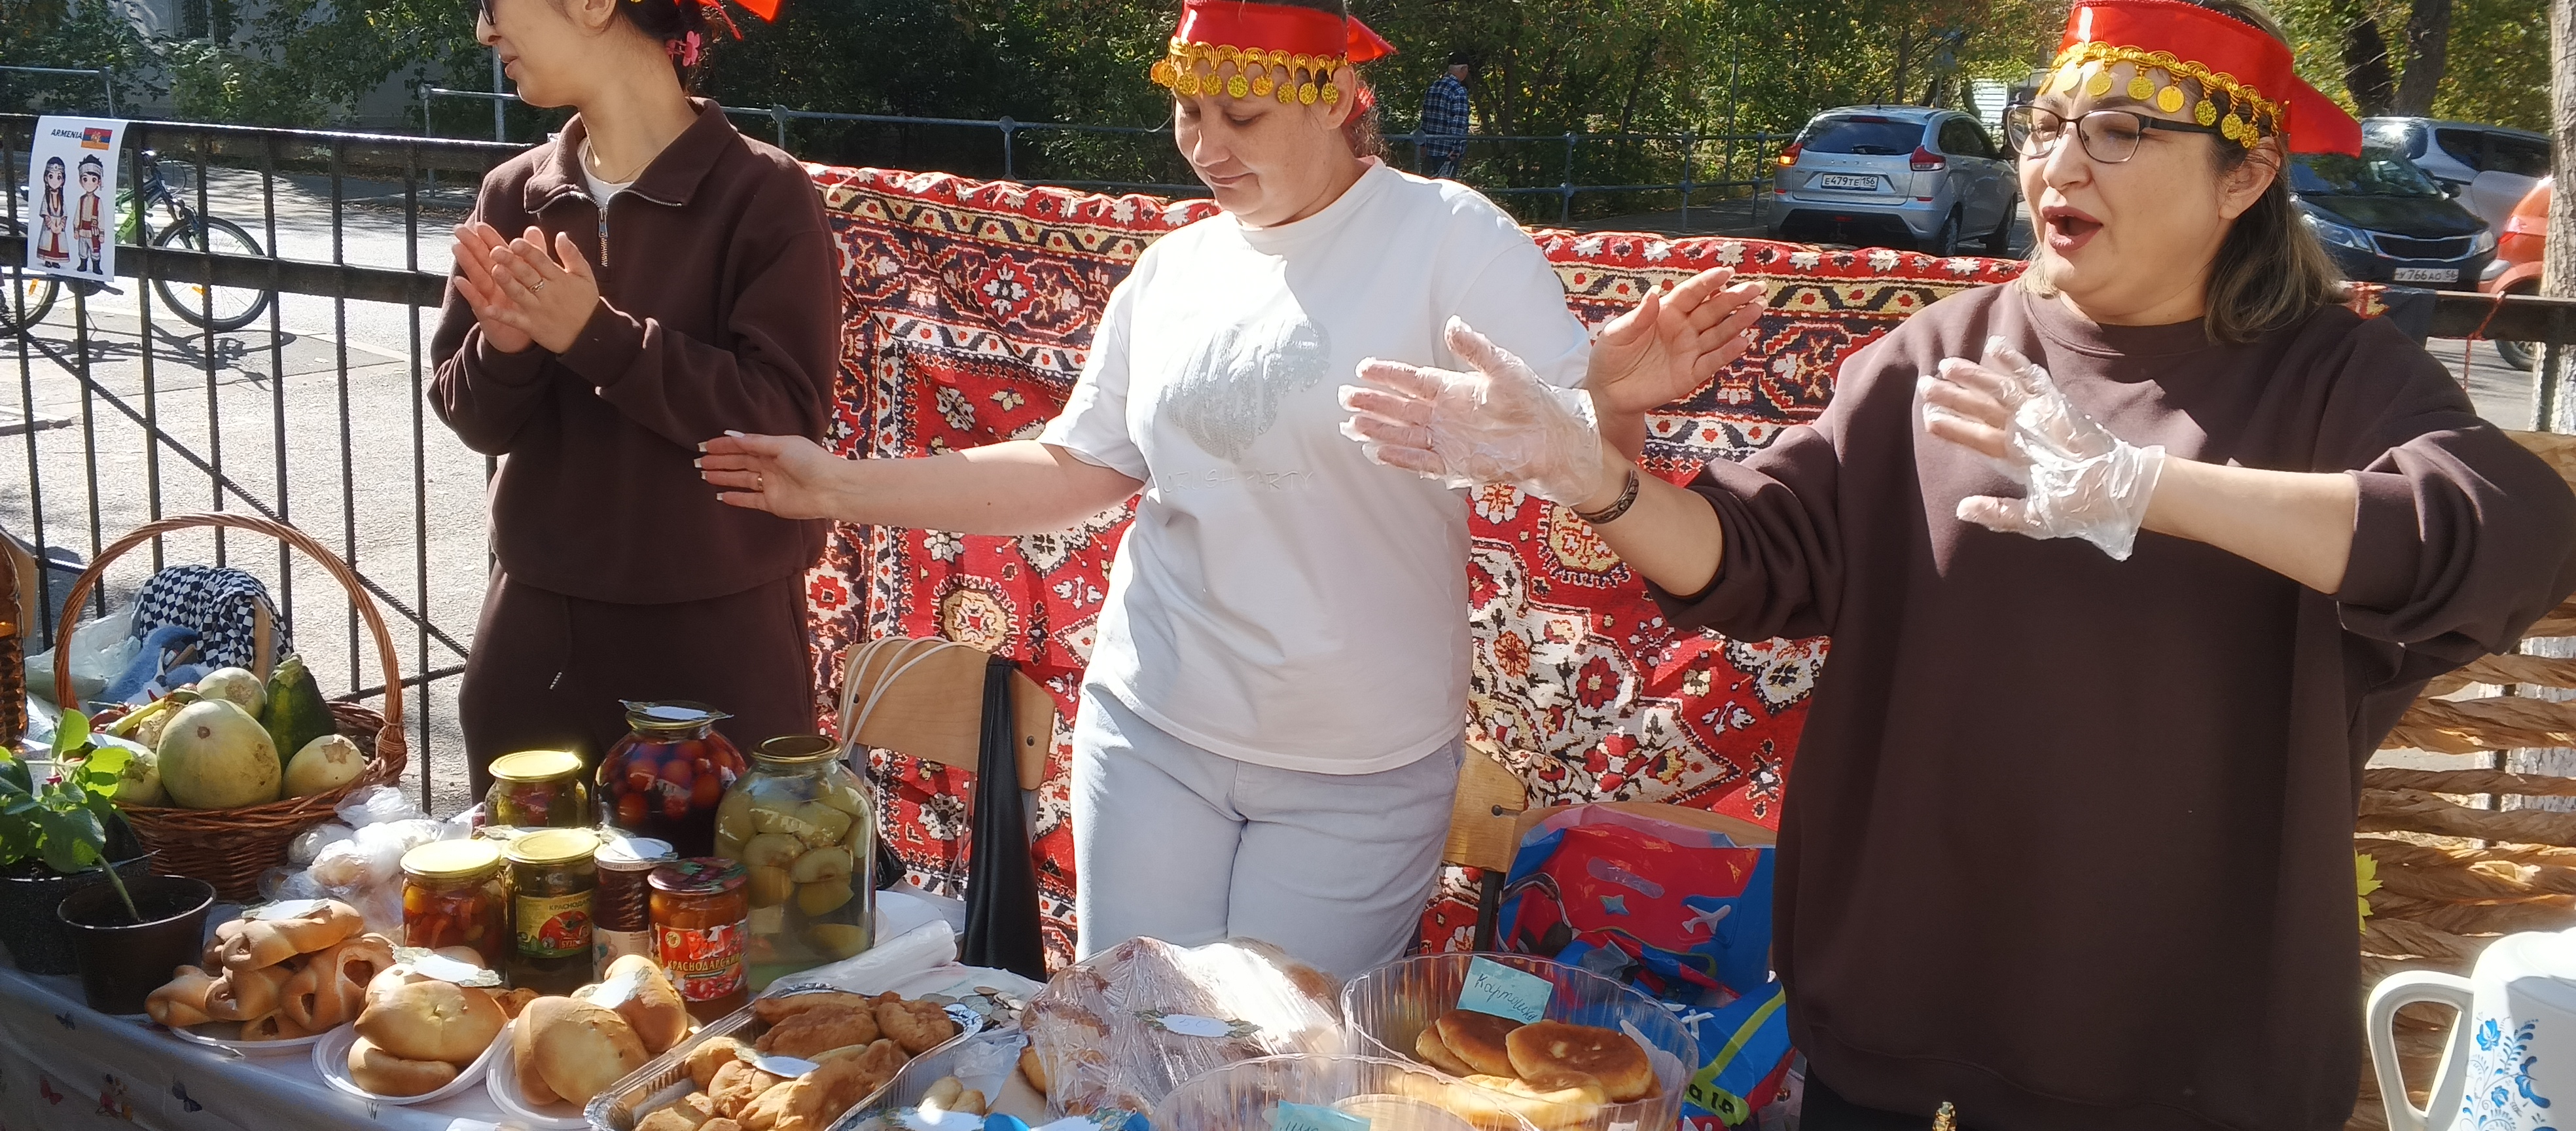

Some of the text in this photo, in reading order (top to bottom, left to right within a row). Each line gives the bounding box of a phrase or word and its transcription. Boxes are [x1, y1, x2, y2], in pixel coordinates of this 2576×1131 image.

[50, 128, 83, 139] ARMENIA
[1824, 176, 1876, 187] Е479ТЕ 156
[1474, 973, 1538, 1022] Картошка
